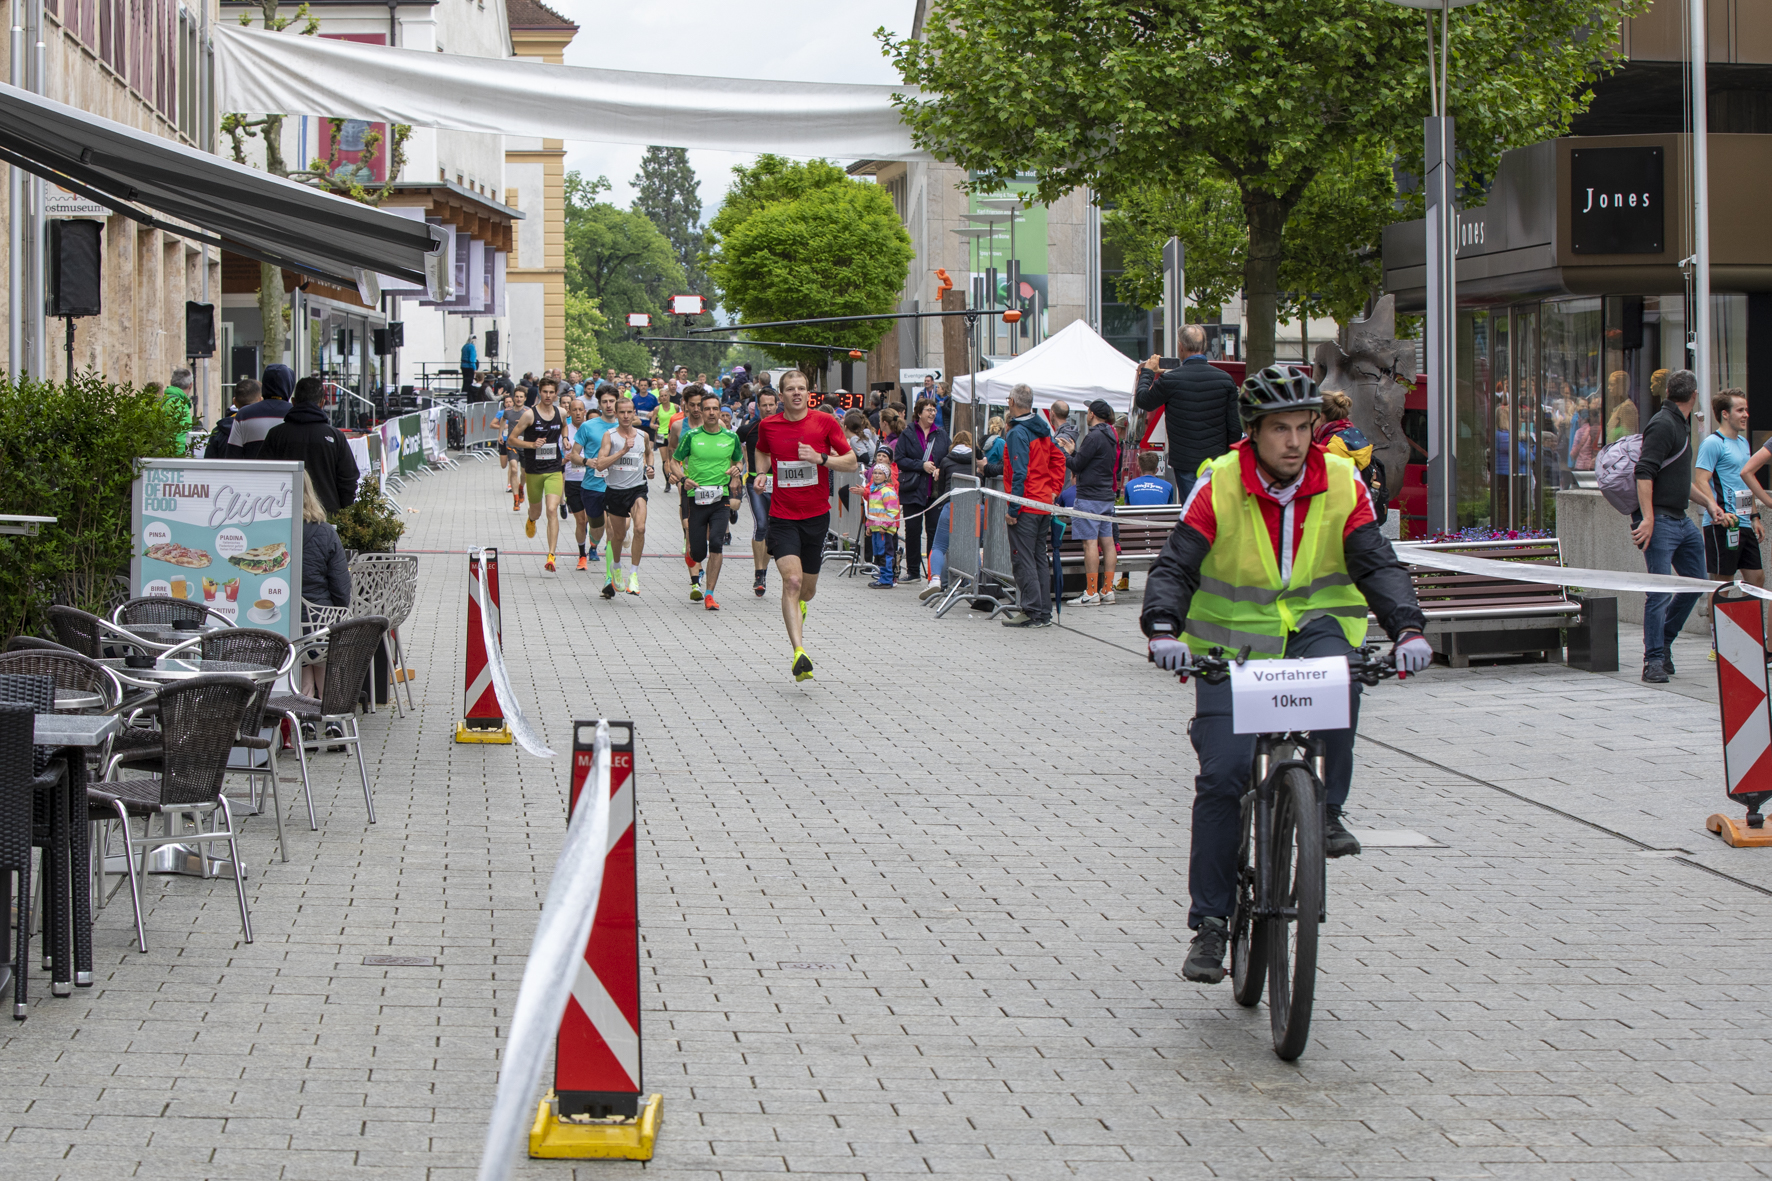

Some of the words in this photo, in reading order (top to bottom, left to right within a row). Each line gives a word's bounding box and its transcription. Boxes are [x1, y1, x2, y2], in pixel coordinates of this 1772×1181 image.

[1583, 187, 1650, 214] Jones
[45, 203, 105, 213] ostmuseum
[1455, 214, 1485, 255] Jones
[540, 447, 554, 456] 1008
[619, 457, 633, 466] 1001
[144, 469, 185, 483] TASTE
[784, 468, 805, 479] 1014
[144, 483, 161, 497] OF
[162, 483, 210, 498] ITALIAN
[700, 490, 715, 499] 1143
[144, 497, 178, 512] FOOD
[208, 482, 293, 530] Elisa's
[219, 534, 244, 542] PIADINA
[1252, 669, 1329, 682] Vorfahrer
[1271, 694, 1313, 708] 10km
